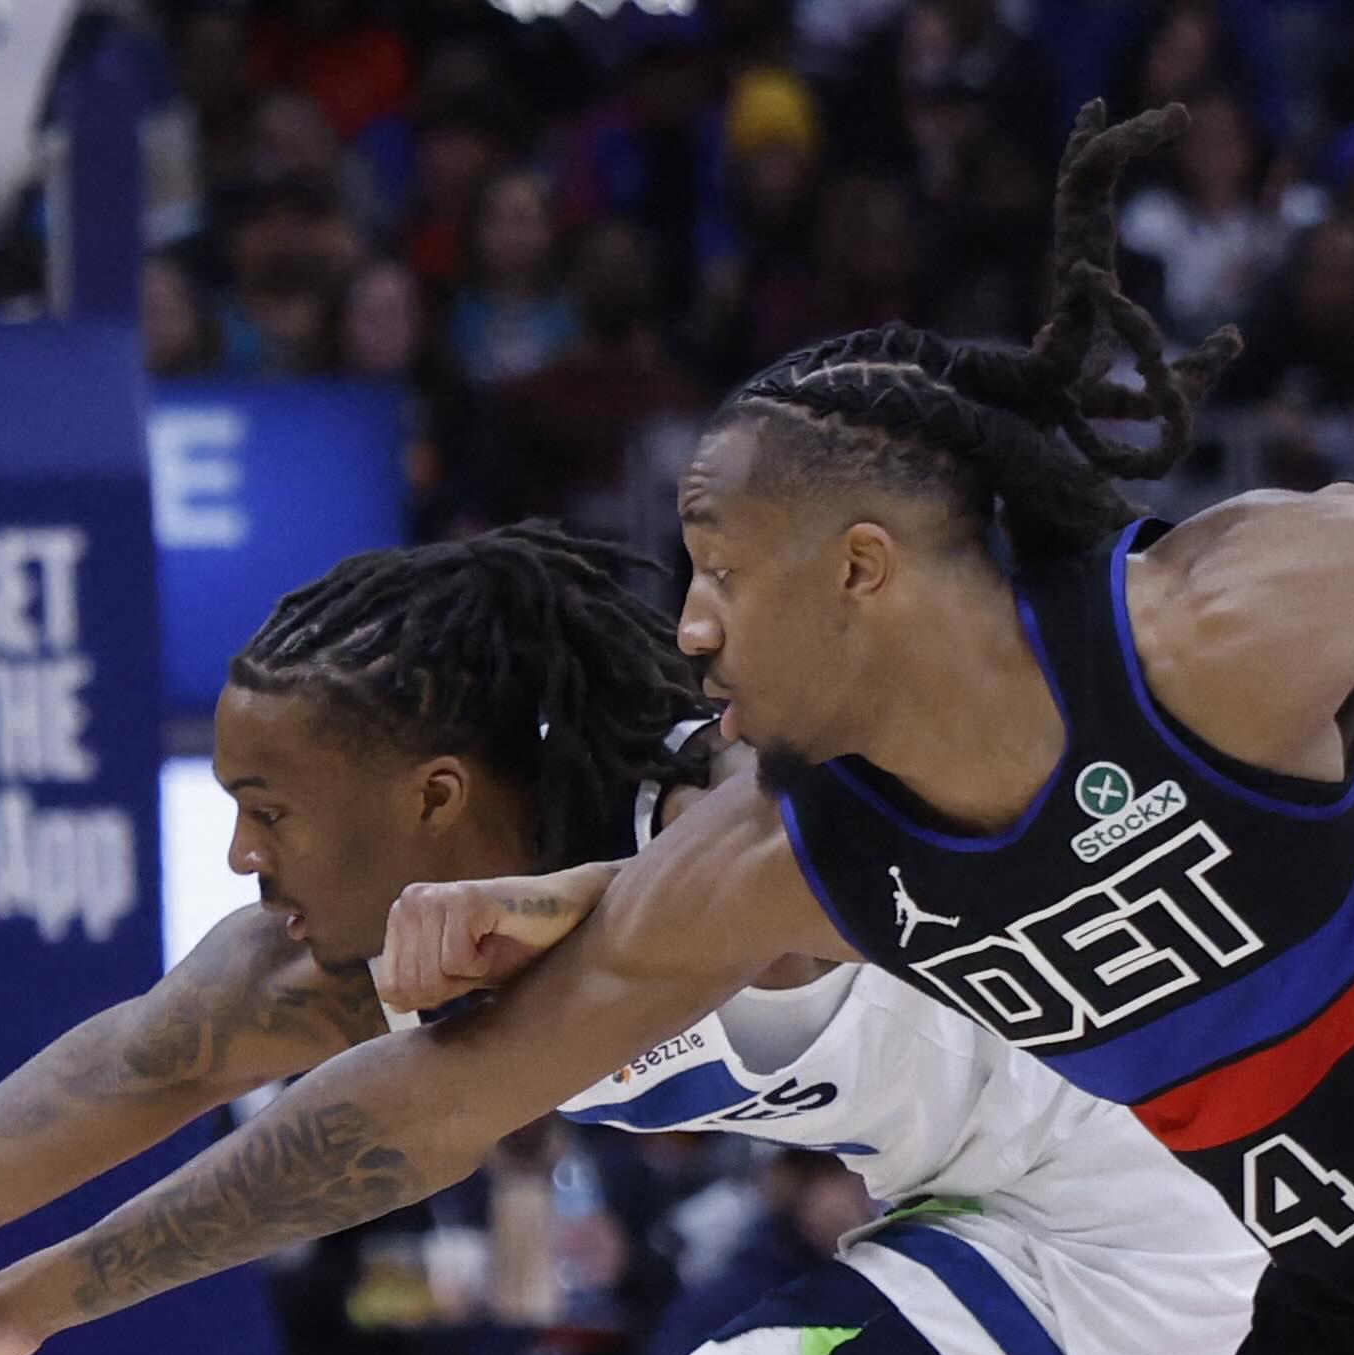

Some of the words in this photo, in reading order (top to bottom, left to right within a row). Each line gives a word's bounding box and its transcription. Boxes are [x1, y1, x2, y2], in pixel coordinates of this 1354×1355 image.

[1076, 785, 1182, 858] StockX
[909, 820, 1266, 1048] DET
[630, 1032, 706, 1076] sezzle
